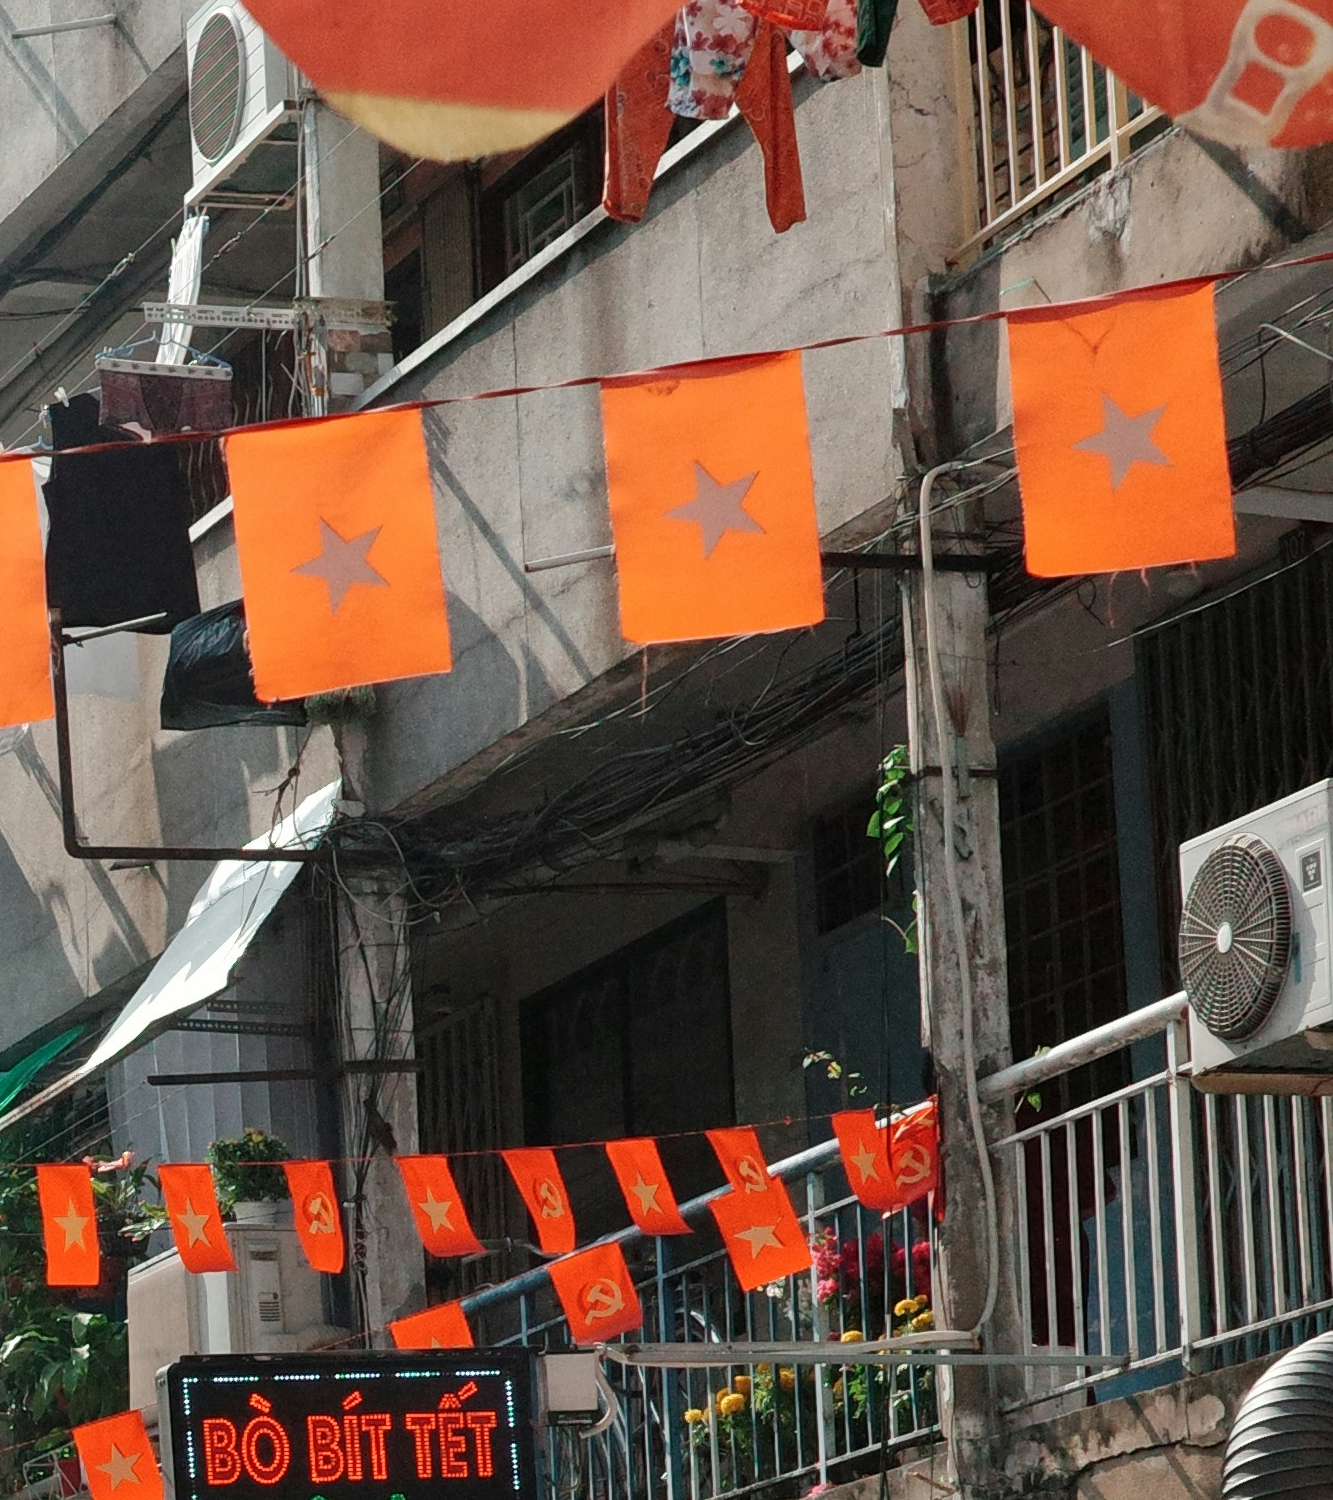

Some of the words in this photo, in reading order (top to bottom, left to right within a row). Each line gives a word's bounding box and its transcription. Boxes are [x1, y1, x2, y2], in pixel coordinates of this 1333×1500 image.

[202, 1392, 290, 1485] BÒ
[306, 1390, 392, 1484] BÍT
[404, 1380, 498, 1480] TẾT
